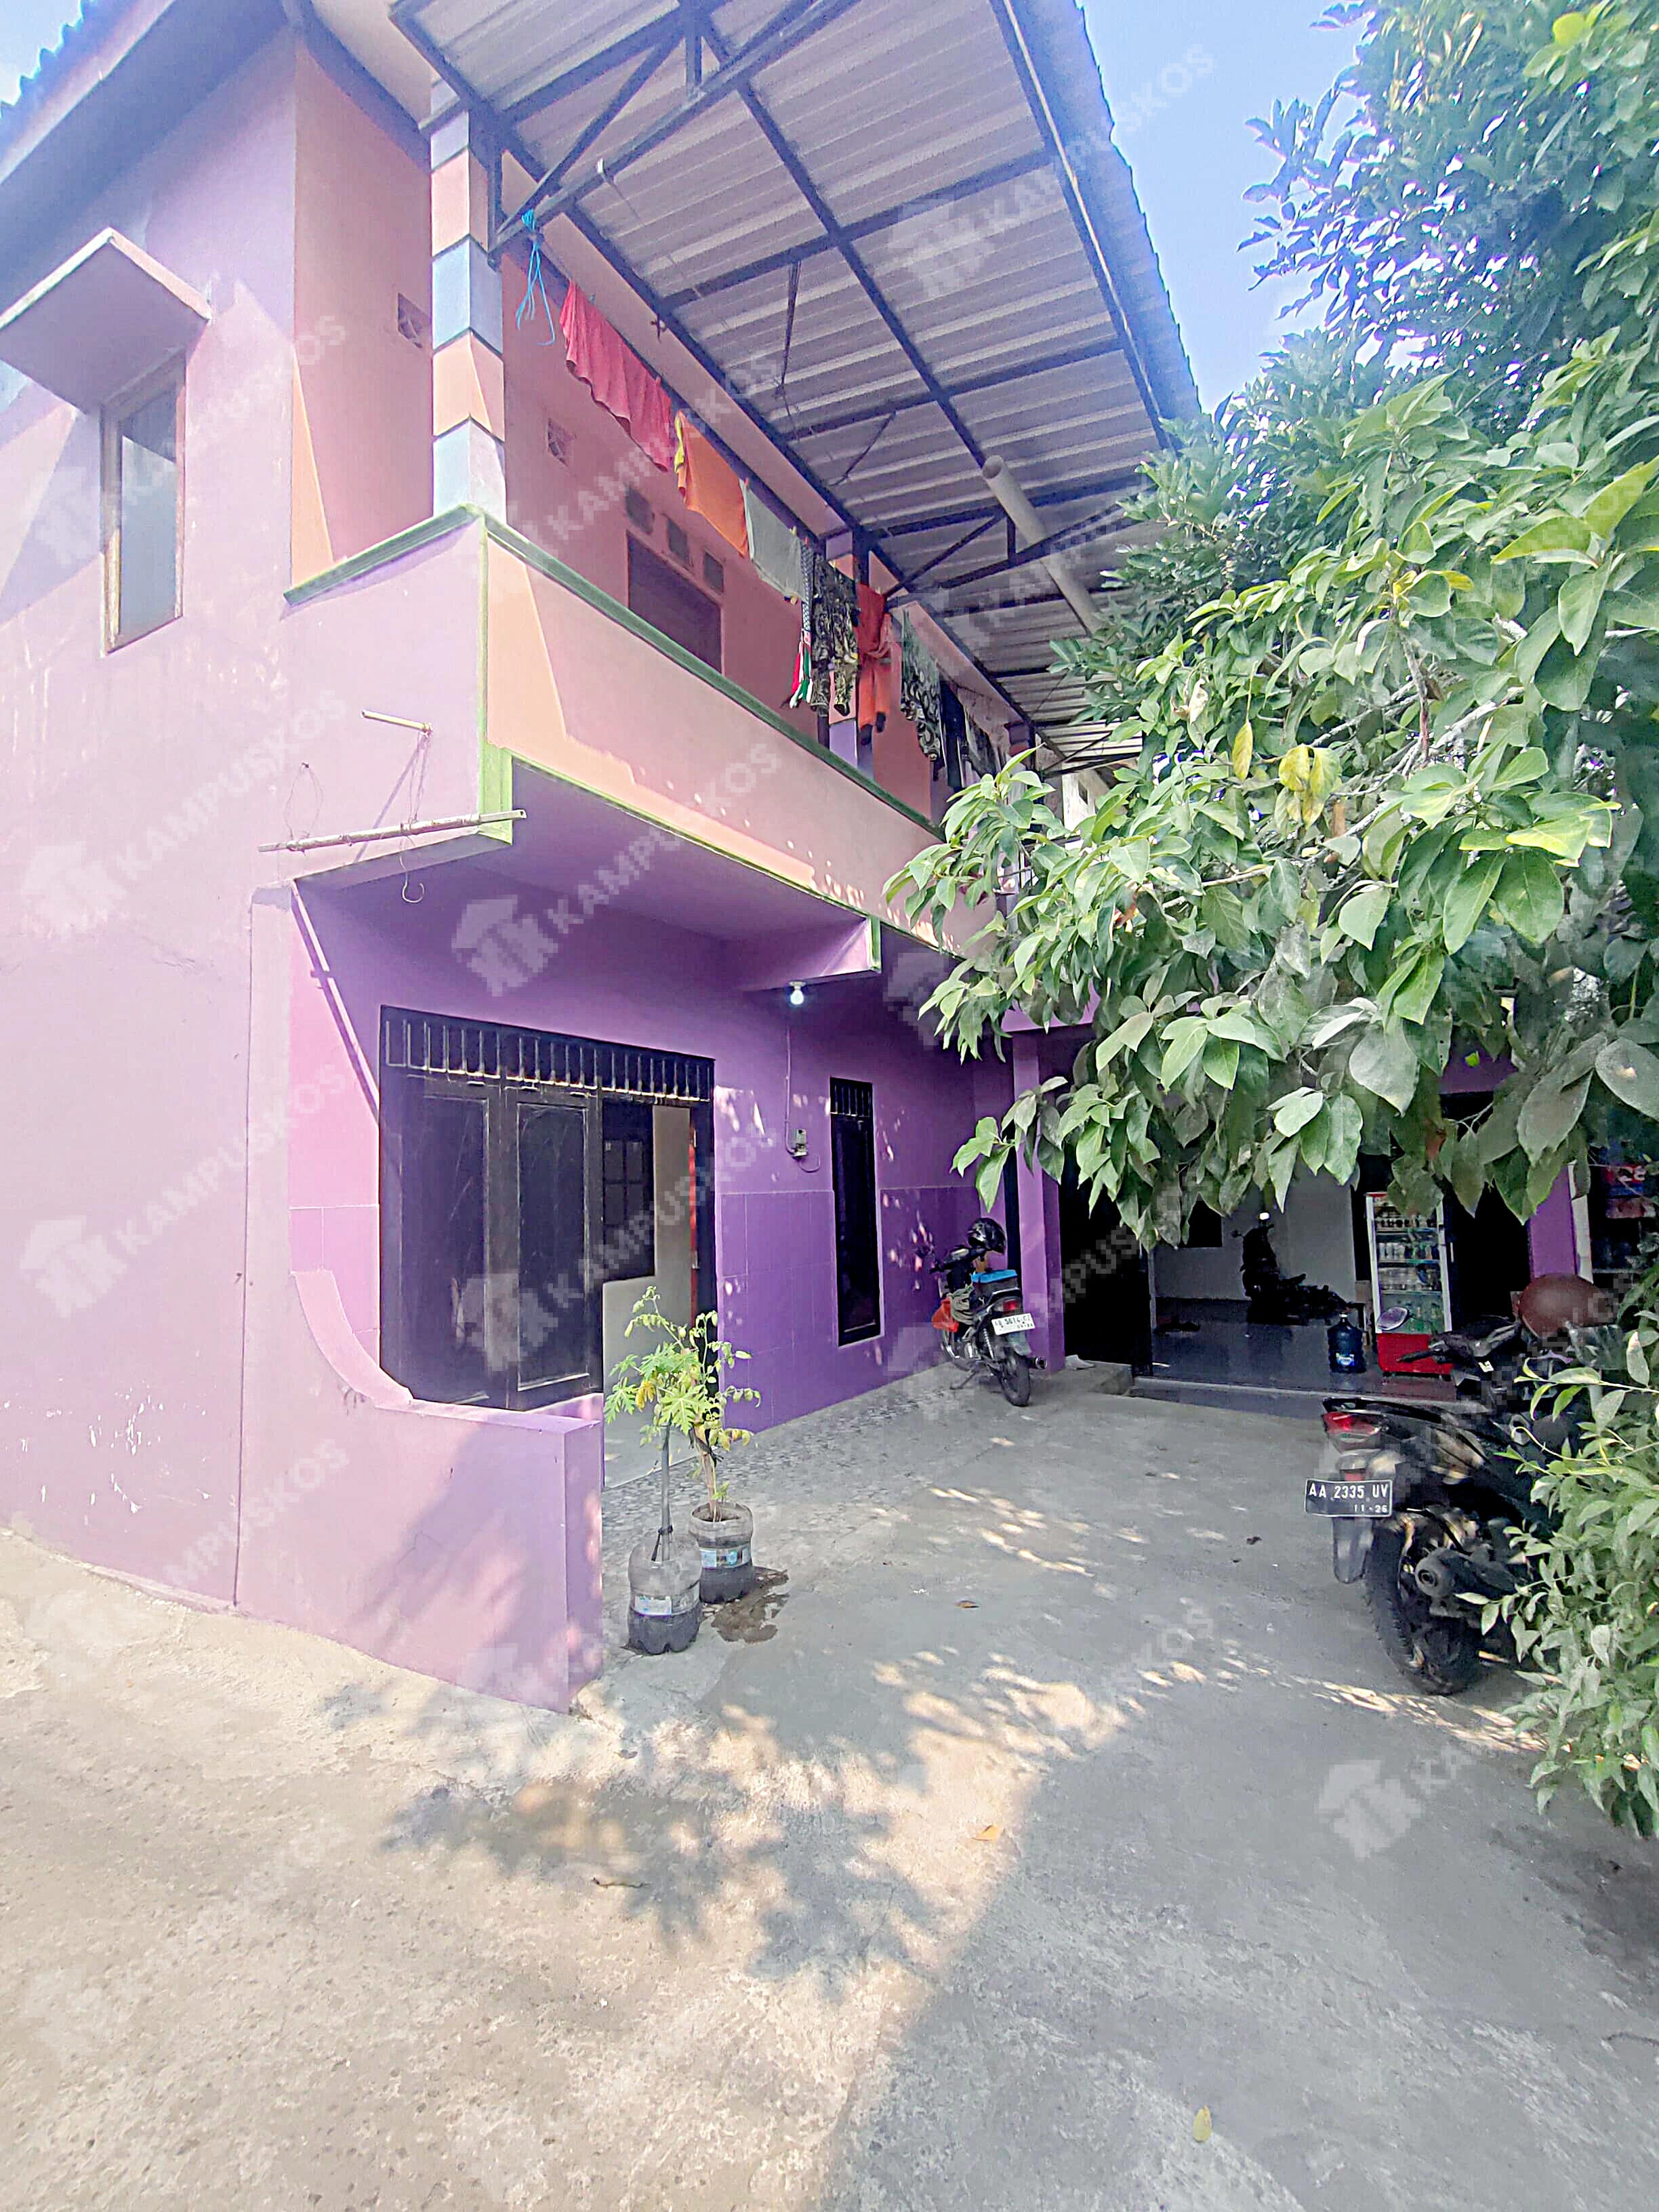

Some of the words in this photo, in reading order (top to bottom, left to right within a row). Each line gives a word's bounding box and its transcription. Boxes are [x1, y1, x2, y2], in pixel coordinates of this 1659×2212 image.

[1309, 1483, 1326, 1498] AA
[1334, 1485, 1365, 1498] 2335
[1372, 1484, 1388, 1498] UV
[1354, 1504, 1388, 1513] 11-26
